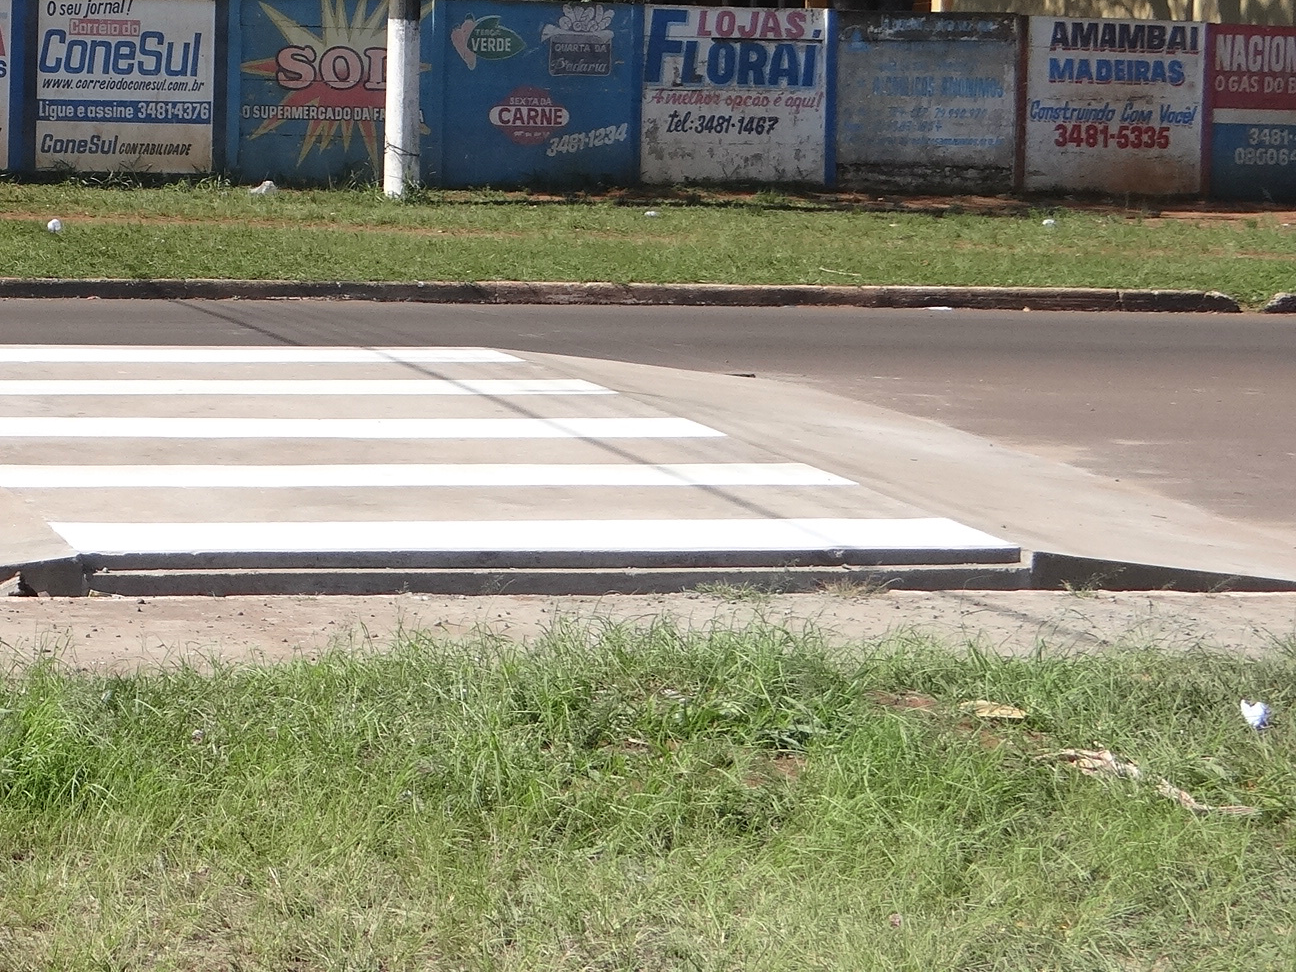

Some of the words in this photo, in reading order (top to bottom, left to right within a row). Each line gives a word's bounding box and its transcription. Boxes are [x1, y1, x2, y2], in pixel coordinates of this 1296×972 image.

[47, 1, 56, 16] O
[59, 2, 81, 15] seu
[122, 21, 139, 35] do
[696, 10, 807, 39] LOJAS
[471, 38, 511, 52] VERDE
[1050, 21, 1199, 52] AMAMBAI
[39, 28, 202, 77] ConeSul
[555, 43, 591, 52] QUARTA
[594, 44, 607, 52] DA
[1048, 57, 1186, 86] MADEIRAS
[42, 78, 205, 92] www.correiodoconesul.com.br
[1215, 75, 1224, 91] O
[1264, 76, 1284, 93] DO
[509, 97, 539, 105] SEXTA
[540, 98, 552, 106] DA
[665, 89, 721, 105] melhor
[38, 101, 73, 120] Ligue
[78, 106, 86, 118] e
[88, 102, 134, 118] assine
[242, 105, 250, 119] O
[252, 106, 352, 120] SUPERMERCADO
[354, 107, 371, 121] DA
[498, 107, 563, 125] CARNE
[1029, 99, 1116, 123] Construindo
[41, 134, 118, 155] ConeSul
[118, 143, 192, 156] CONTABILIDADE
[1054, 124, 1170, 149] 3481-5335
